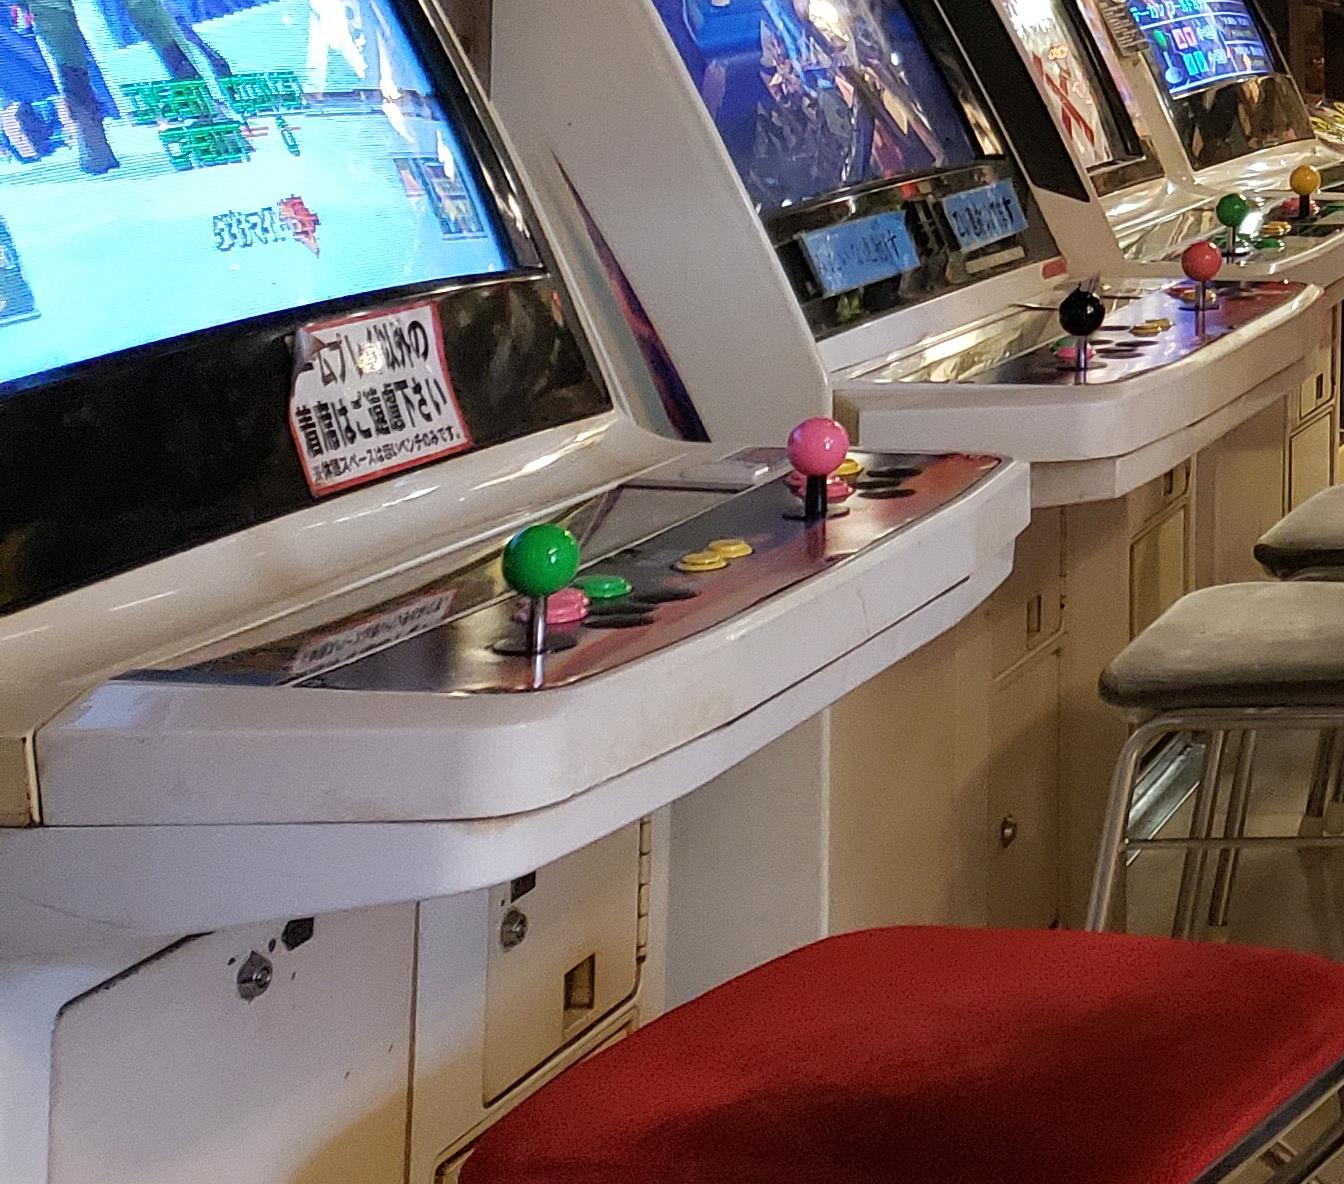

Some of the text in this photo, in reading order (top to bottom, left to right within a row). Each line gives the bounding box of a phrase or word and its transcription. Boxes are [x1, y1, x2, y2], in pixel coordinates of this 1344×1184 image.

[295, 376, 448, 459] 着席はご遠慮下さい
